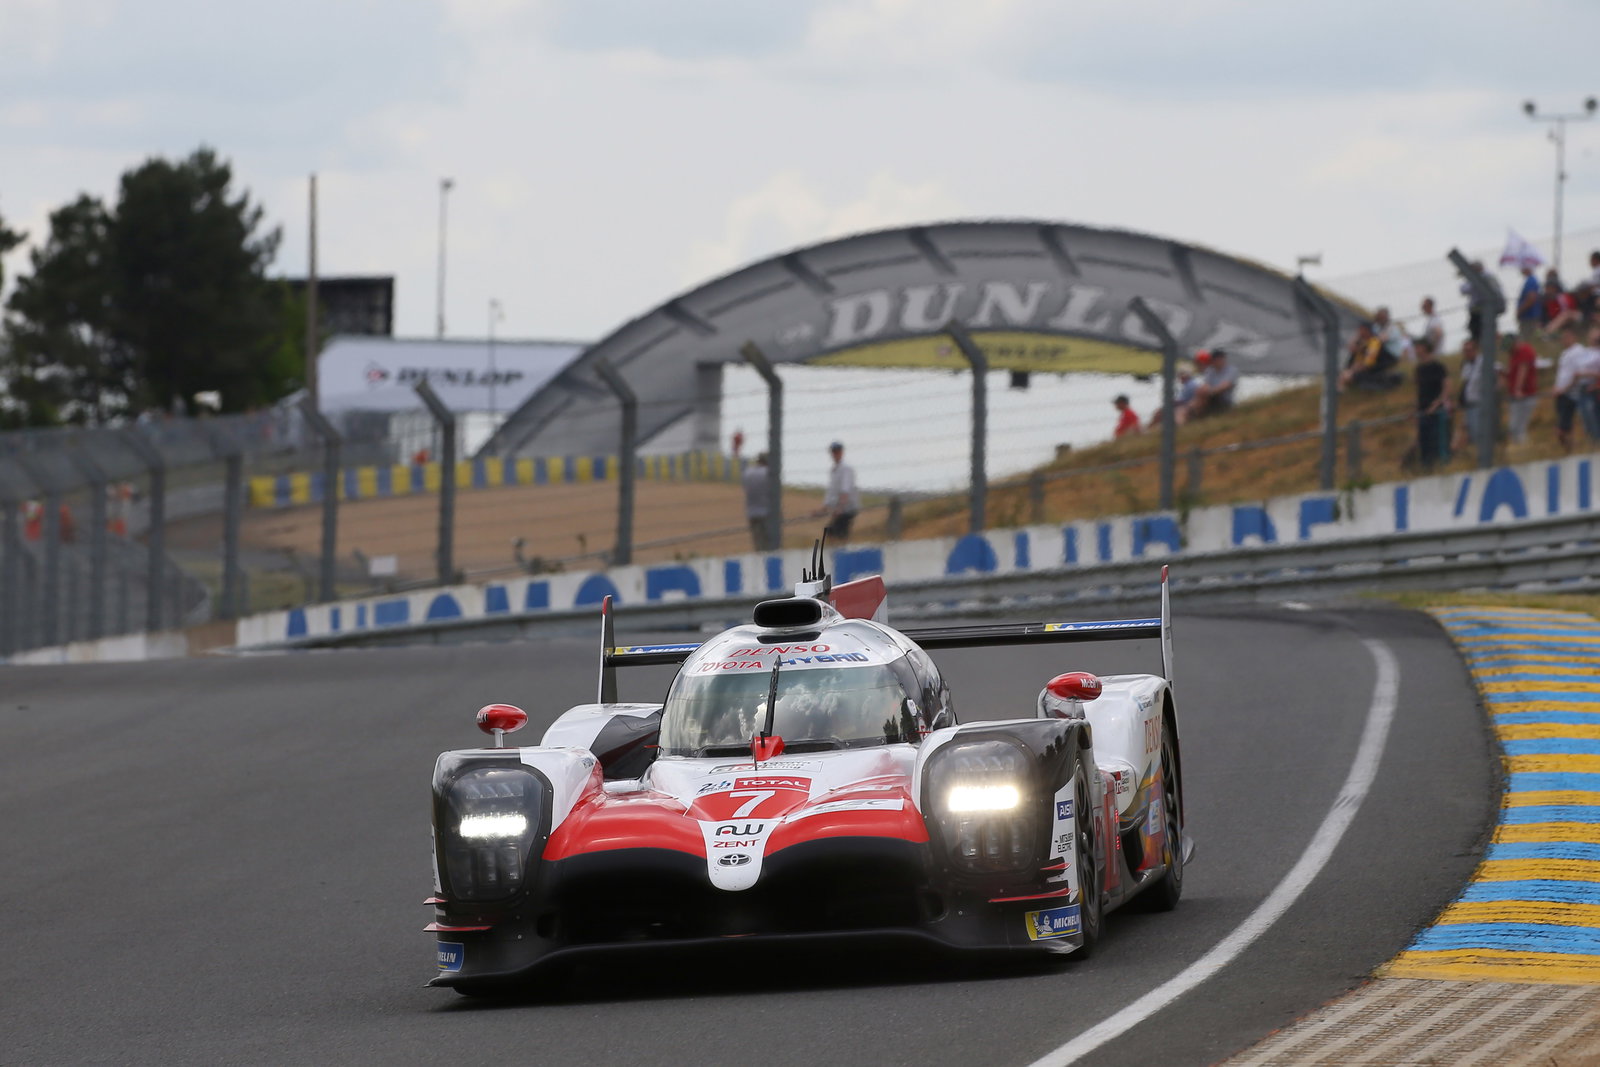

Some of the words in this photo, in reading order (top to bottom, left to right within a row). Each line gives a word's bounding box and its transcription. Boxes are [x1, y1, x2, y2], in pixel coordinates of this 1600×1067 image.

[728, 644, 831, 659] DENSO
[697, 661, 763, 673] TOYOTA
[778, 652, 870, 669] HYBRID
[738, 778, 808, 788] TOTAL
[729, 789, 777, 819] 7
[713, 838, 761, 849] ZENT
